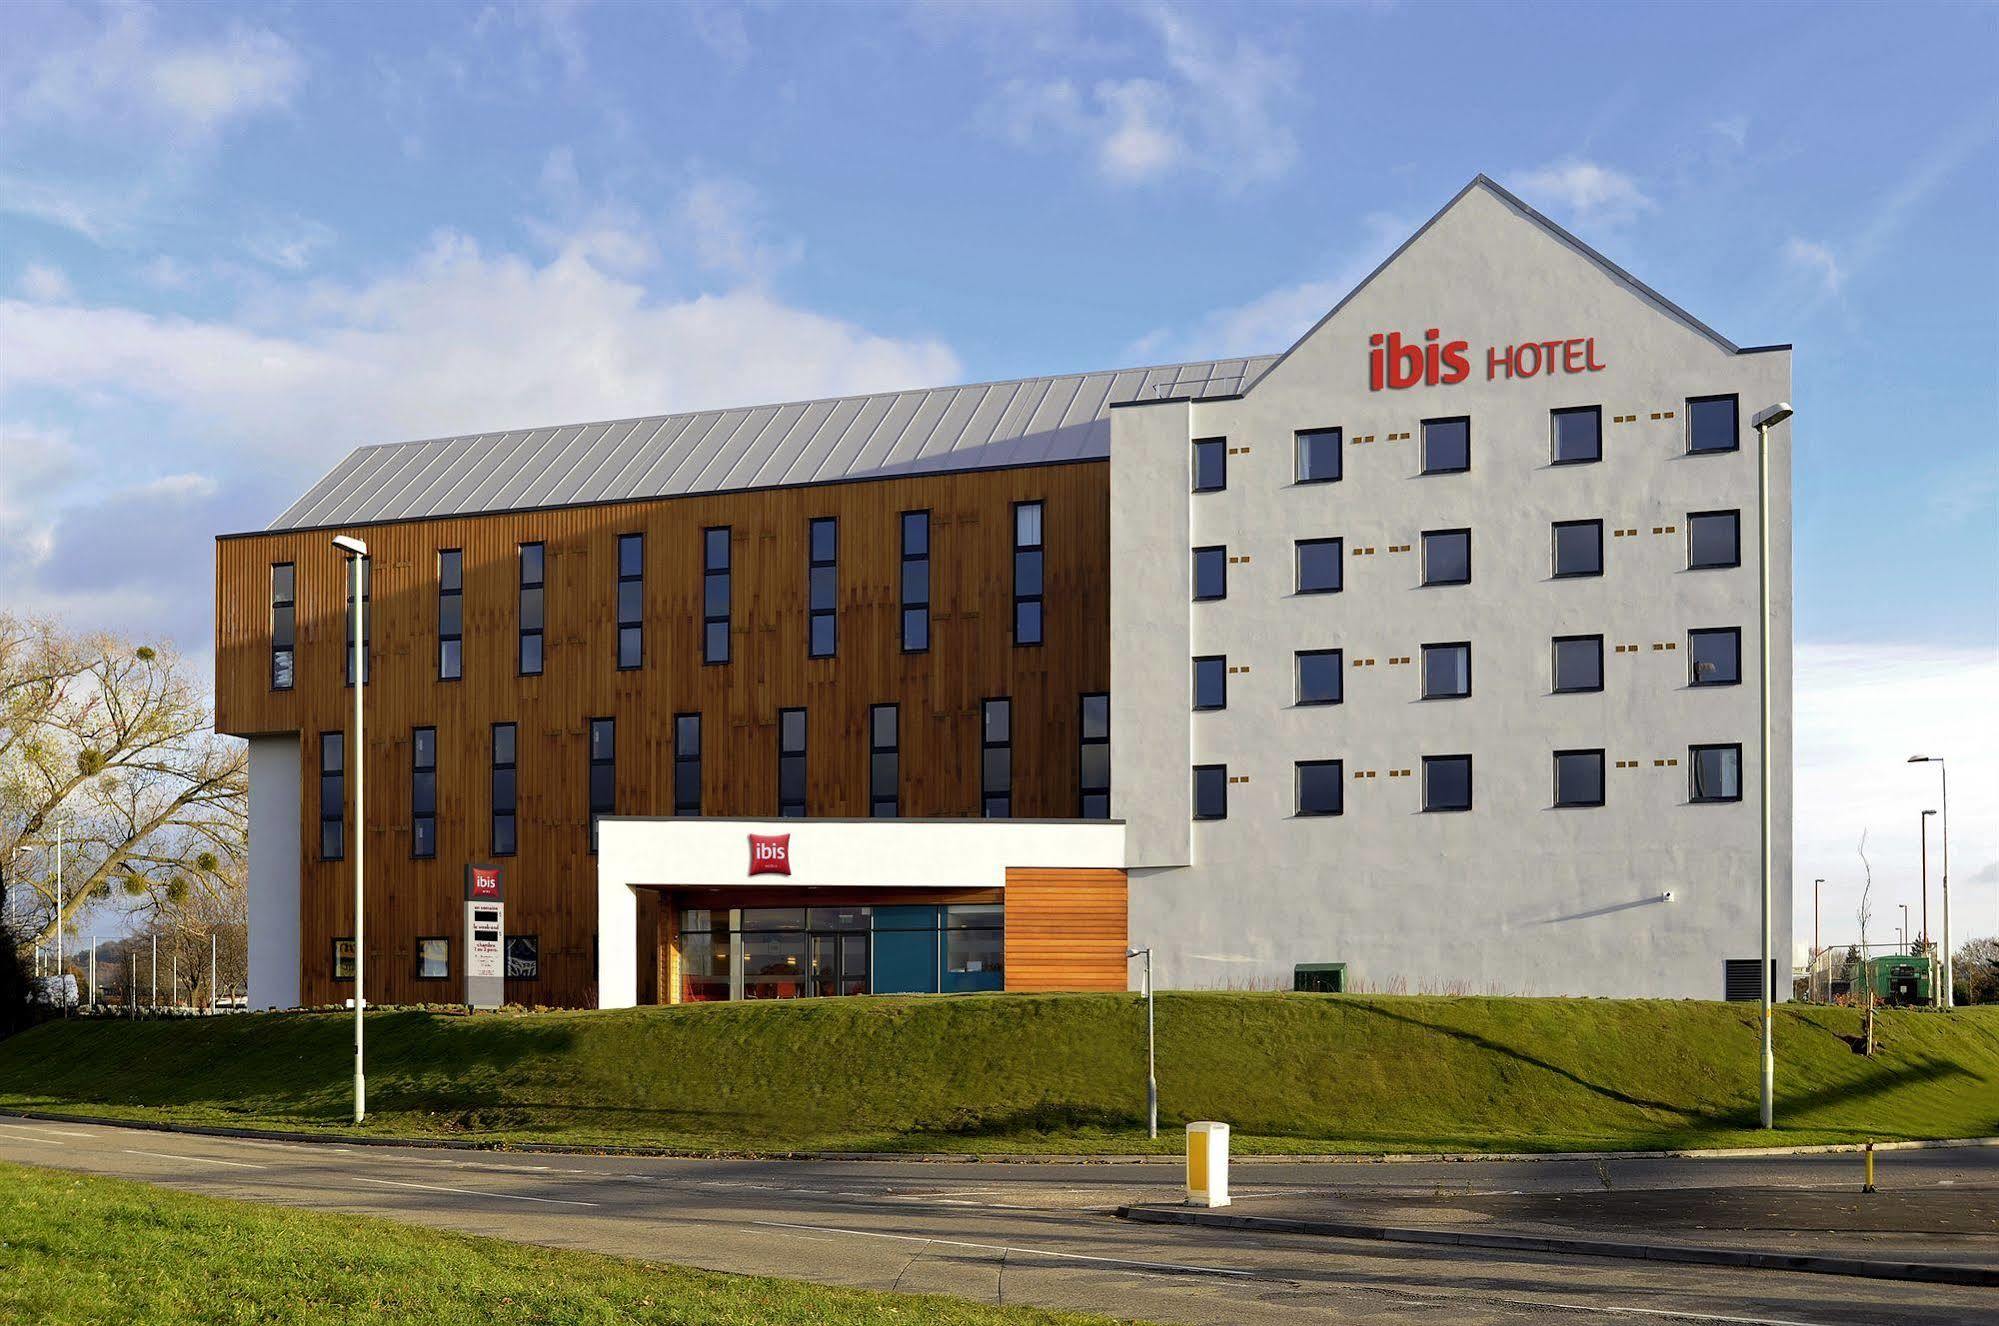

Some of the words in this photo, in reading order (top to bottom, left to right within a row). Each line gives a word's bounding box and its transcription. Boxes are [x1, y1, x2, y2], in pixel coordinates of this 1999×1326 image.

[1370, 328, 1471, 391] ibis
[1487, 337, 1606, 381] HOTEL
[756, 842, 785, 859] ibis
[476, 875, 496, 888] ibis
